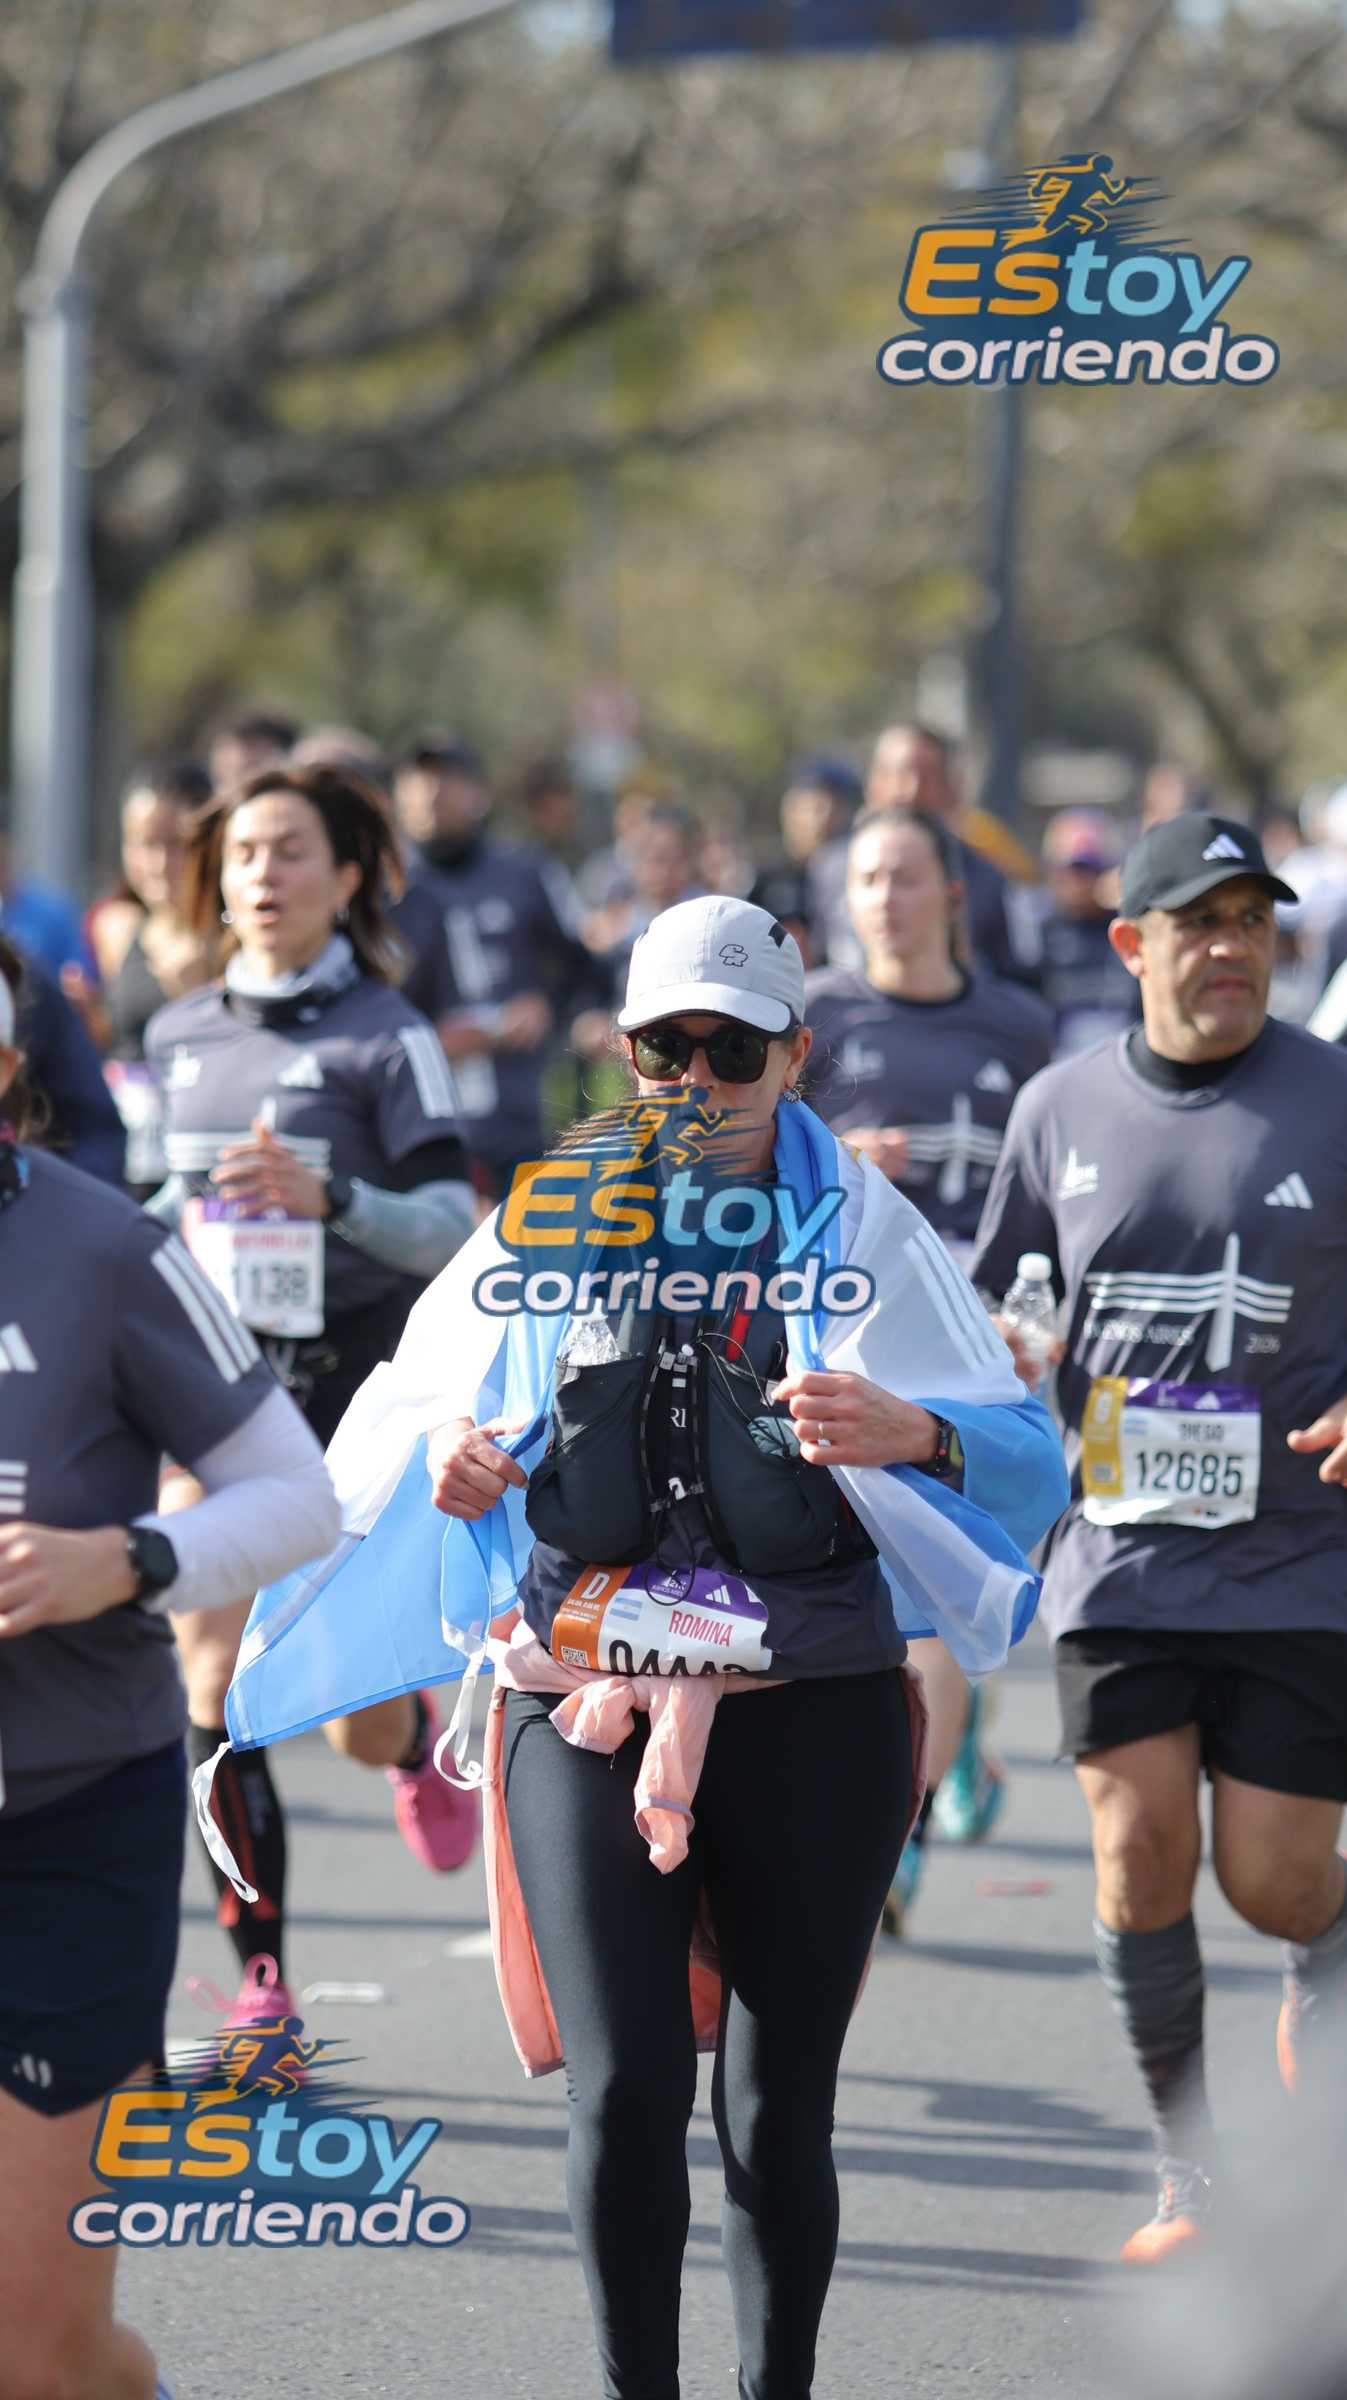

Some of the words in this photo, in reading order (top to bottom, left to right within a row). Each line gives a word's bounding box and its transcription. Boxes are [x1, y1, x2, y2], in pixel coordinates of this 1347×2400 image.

[1137, 1450, 1243, 1497] 12685
[581, 1571, 610, 1600] D
[668, 1609, 734, 1647] ROMINA
